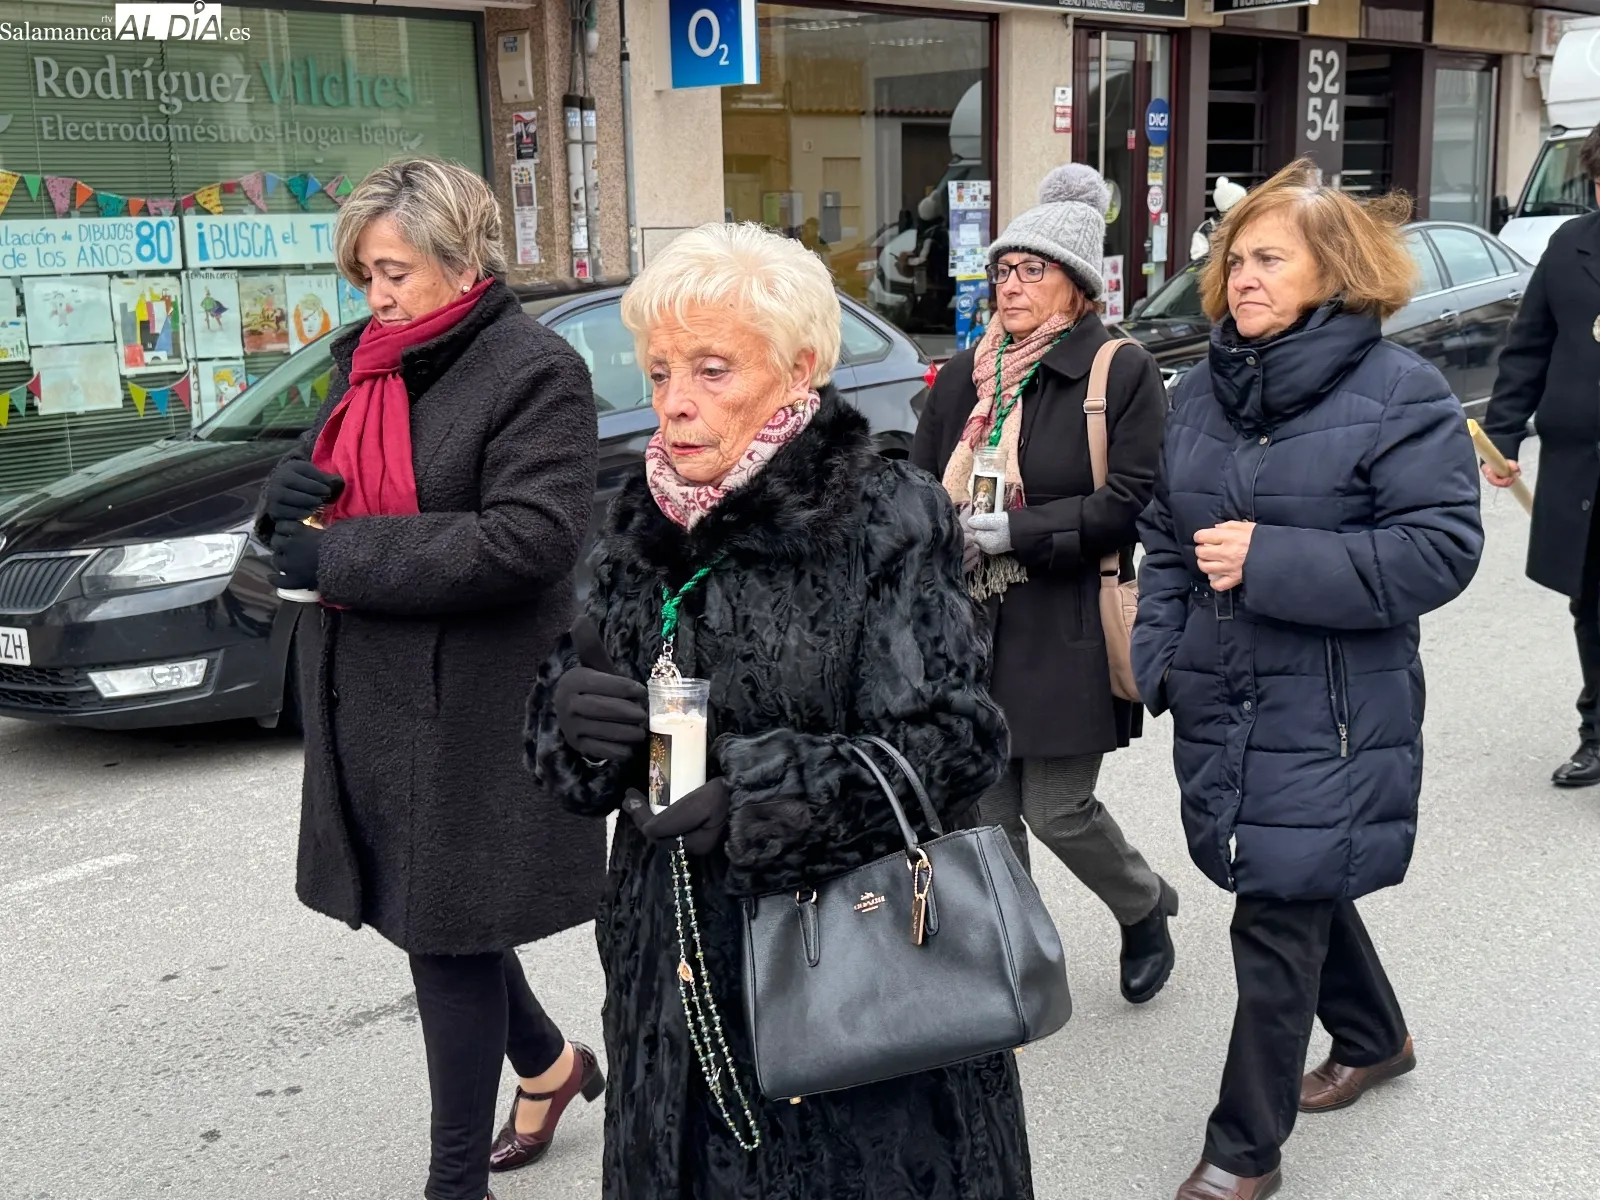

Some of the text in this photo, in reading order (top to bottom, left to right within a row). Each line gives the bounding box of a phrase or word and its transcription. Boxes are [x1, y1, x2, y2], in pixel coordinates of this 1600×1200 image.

[34, 54, 415, 114] Rodríguez Vilches
[1307, 49, 1340, 94] 52
[1148, 113, 1168, 126] DIGI
[1306, 97, 1340, 141] 54
[0, 226, 57, 246] lación
[62, 231, 72, 241] de
[79, 223, 133, 242] DIBUJOS
[282, 222, 298, 244] el
[3, 244, 133, 269] de los AÑOS
